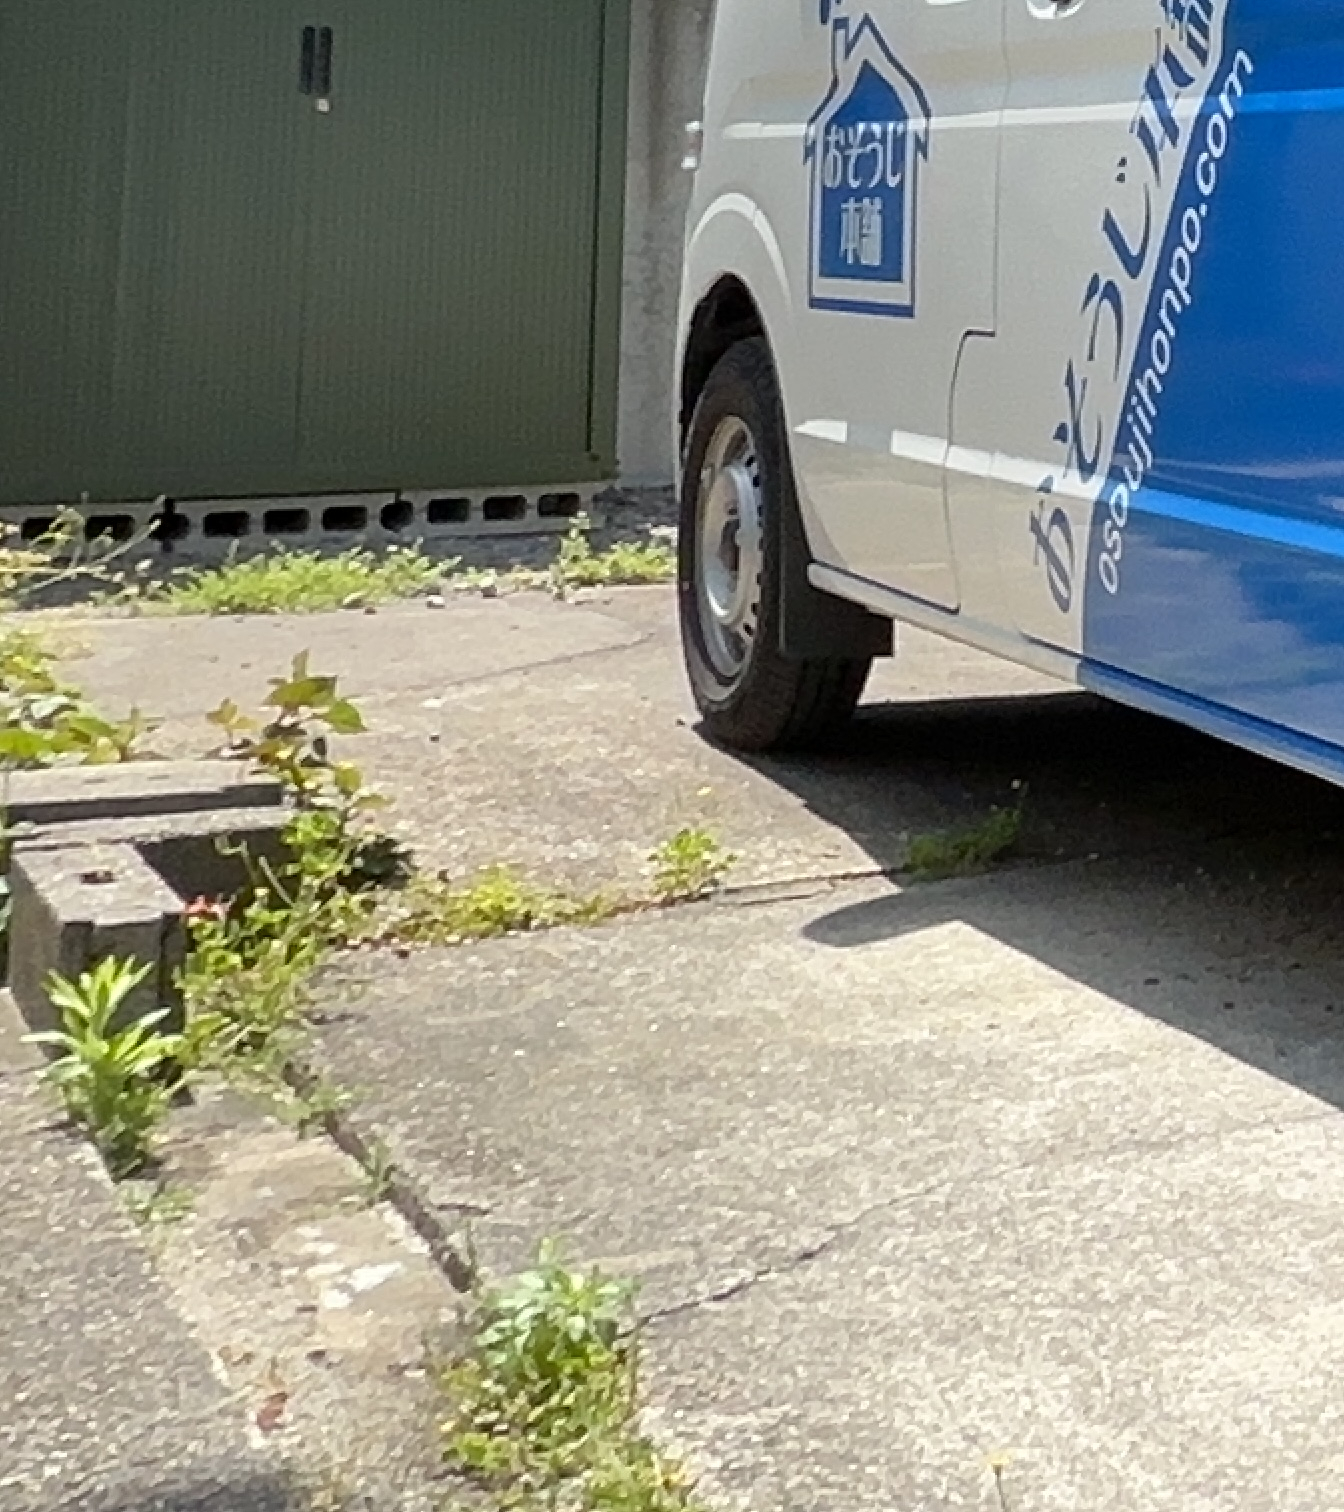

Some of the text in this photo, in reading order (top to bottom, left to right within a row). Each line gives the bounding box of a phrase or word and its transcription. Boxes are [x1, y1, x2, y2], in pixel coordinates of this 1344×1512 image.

[824, 123, 903, 188] おそうじ
[1100, 49, 1254, 594] osoujihonpo.com
